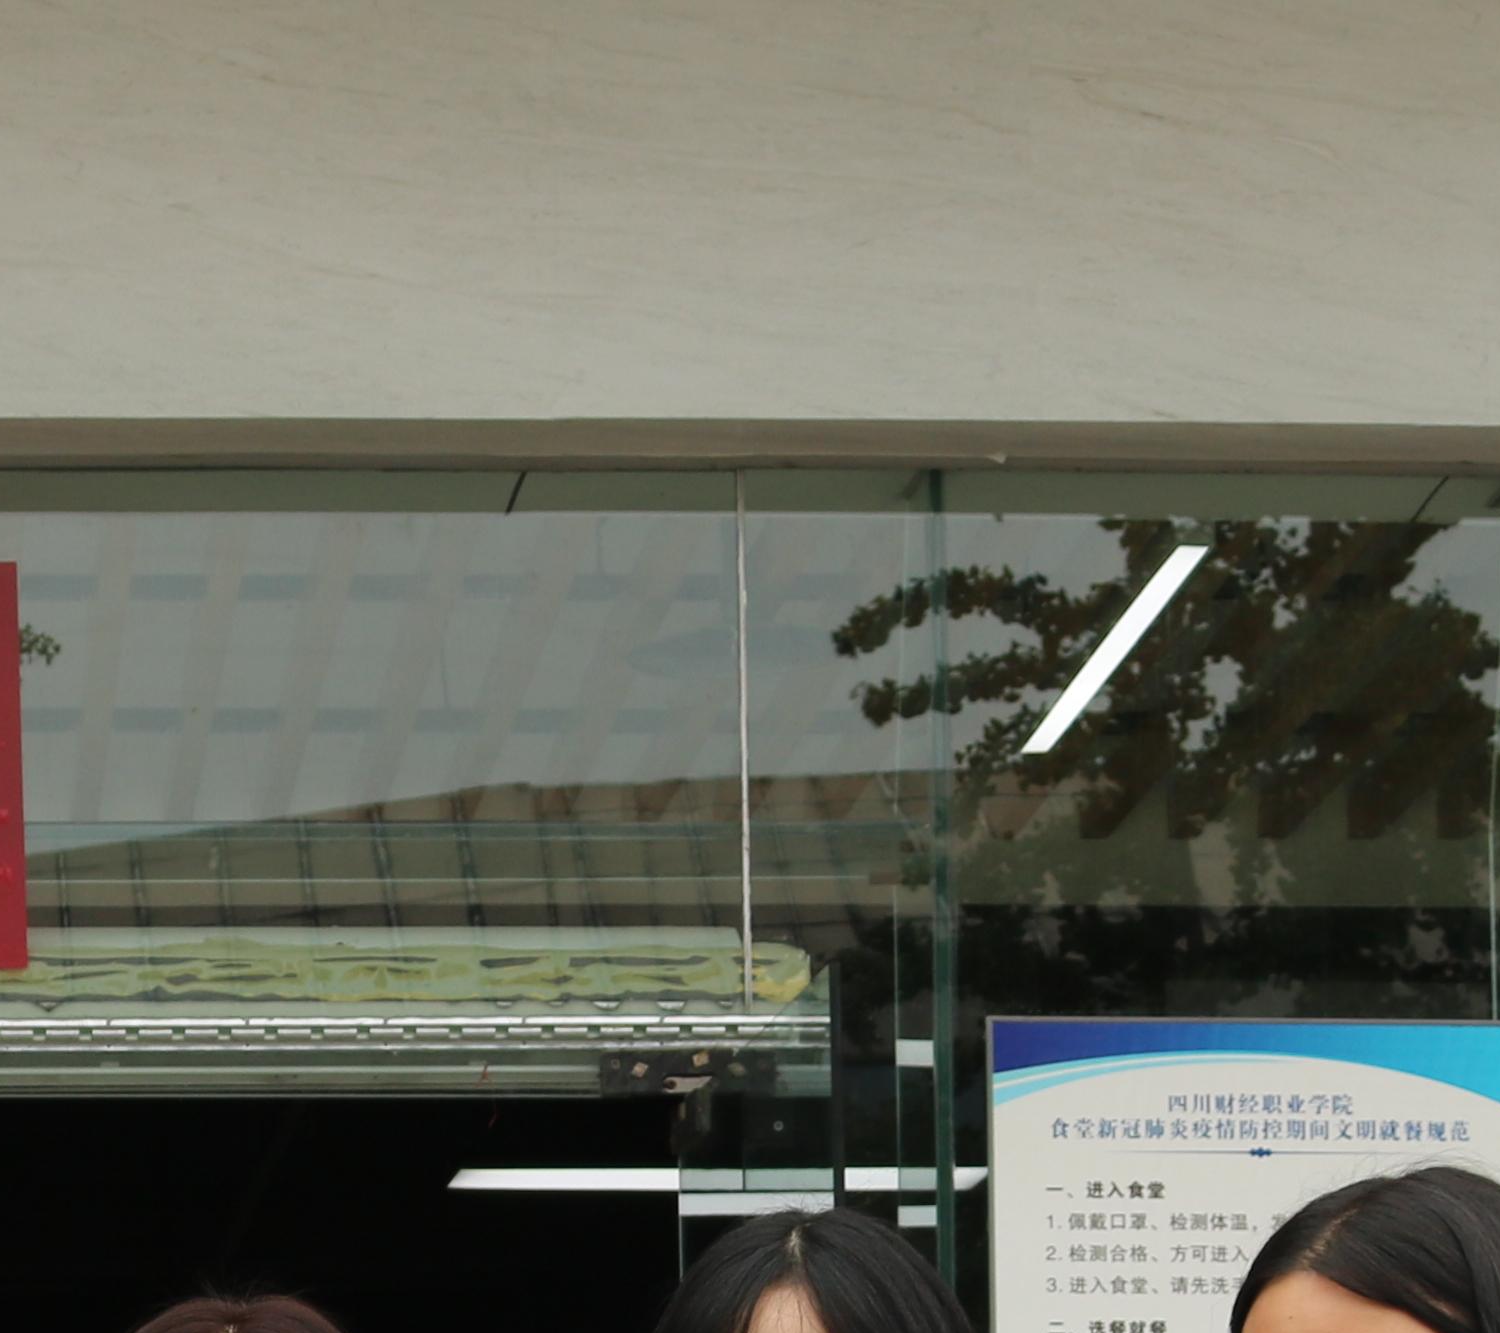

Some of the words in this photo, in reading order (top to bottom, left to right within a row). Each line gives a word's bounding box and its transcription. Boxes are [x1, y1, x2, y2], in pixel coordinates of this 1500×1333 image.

[1167, 1093, 1354, 1116] 四川财经职业学院
[1051, 1117, 1471, 1143] 食堂新冠肺炎疫情防控期间文明就餐规范
[1045, 1181, 1166, 1199] 一、进入食堂
